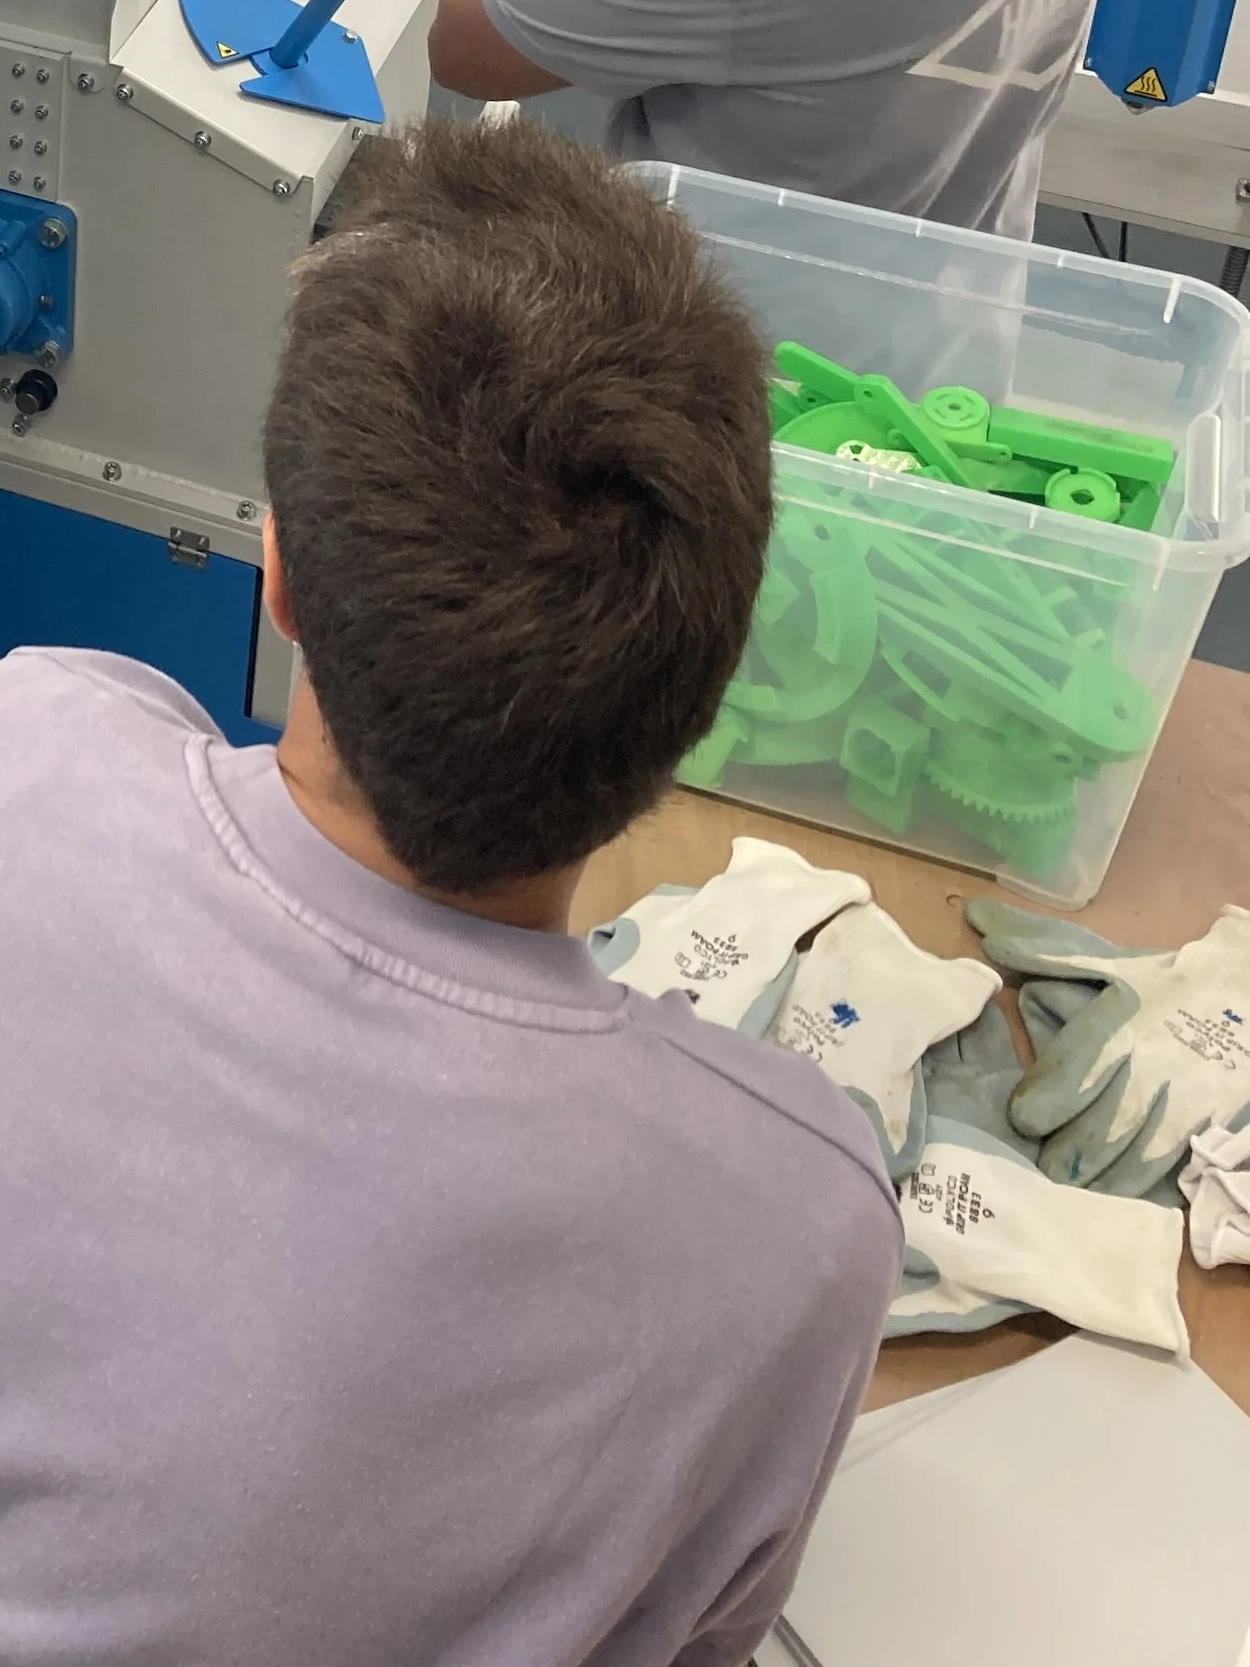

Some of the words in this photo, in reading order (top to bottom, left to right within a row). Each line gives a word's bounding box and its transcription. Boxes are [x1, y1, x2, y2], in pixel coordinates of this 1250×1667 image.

[958, 1173, 970, 1202] FOAM
[918, 1198, 933, 1213] CE
[969, 1192, 981, 1223] 8833
[982, 1208, 995, 1218] 9
